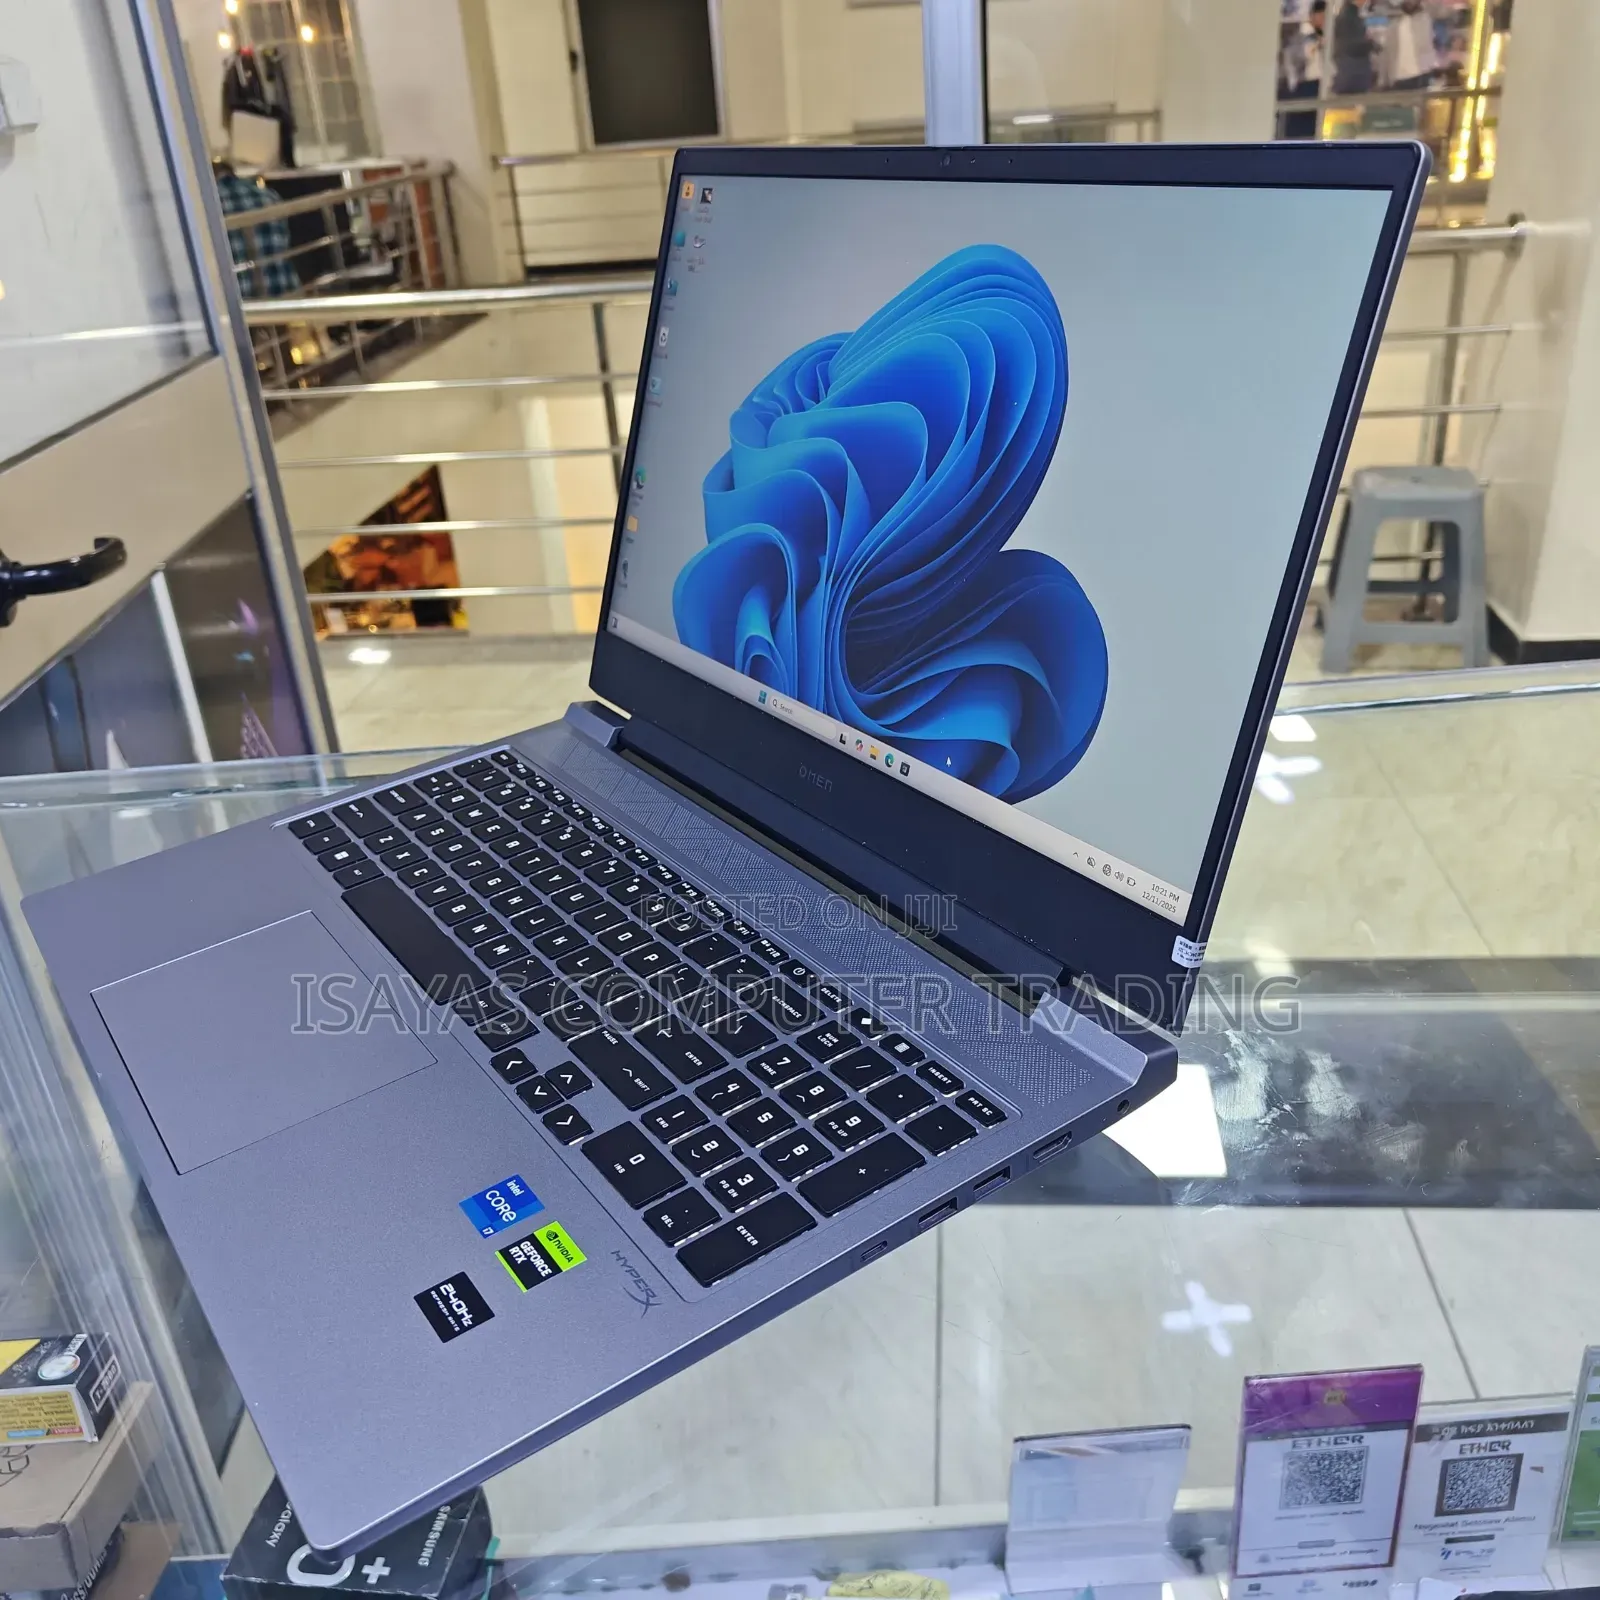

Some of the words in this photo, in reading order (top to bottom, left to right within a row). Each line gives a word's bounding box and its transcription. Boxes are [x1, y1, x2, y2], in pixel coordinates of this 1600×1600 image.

[662, 871, 673, 879] F8
[570, 893, 584, 901] U
[686, 888, 697, 897] F9
[1151, 883, 1168, 897] 10:21
[1169, 892, 1180, 903] PM
[508, 896, 522, 904] H
[1142, 891, 1176, 913] 12/11/2025
[472, 924, 487, 933] N
[737, 926, 750, 935] F11
[618, 932, 632, 941] O
[493, 945, 509, 955] M
[766, 947, 781, 958] F12
[577, 958, 589, 966] L
[821, 987, 843, 1003] DELETE
[772, 995, 802, 1019] BACKSPACE
[601, 1030, 619, 1045] PAUSE
[817, 1035, 833, 1048] LOCK
[685, 1051, 703, 1066] ENTER
[777, 1057, 791, 1065] 7
[760, 1062, 776, 1076] HOME
[928, 1067, 952, 1085] INSERT
[634, 1077, 650, 1092] SHIFT
[728, 1083, 739, 1092] 4
[810, 1086, 824, 1095] 8
[968, 1097, 983, 1109] PRT
[983, 1107, 993, 1116] SC
[656, 1117, 669, 1128] END
[757, 1112, 773, 1123] 5
[846, 1116, 861, 1126] 9
[828, 1121, 838, 1130] PG
[837, 1129, 848, 1138] UP
[703, 1141, 719, 1151] 2
[793, 1144, 808, 1155] 6
[630, 1154, 645, 1164] 0
[614, 1163, 626, 1174] INS
[719, 1179, 729, 1190] PG
[737, 1174, 753, 1185] 3
[506, 1179, 524, 1196] intel
[661, 1215, 674, 1228] DEL
[482, 1226, 494, 1236] i7
[736, 1225, 759, 1246] ENTER
[508, 1246, 528, 1265] RTX
[520, 1241, 553, 1277] GEFORCE
[430, 1290, 450, 1317] REFRESH
[439, 1284, 473, 1327] 240Hz
[418, 1505, 451, 1567] SAMSUNG
